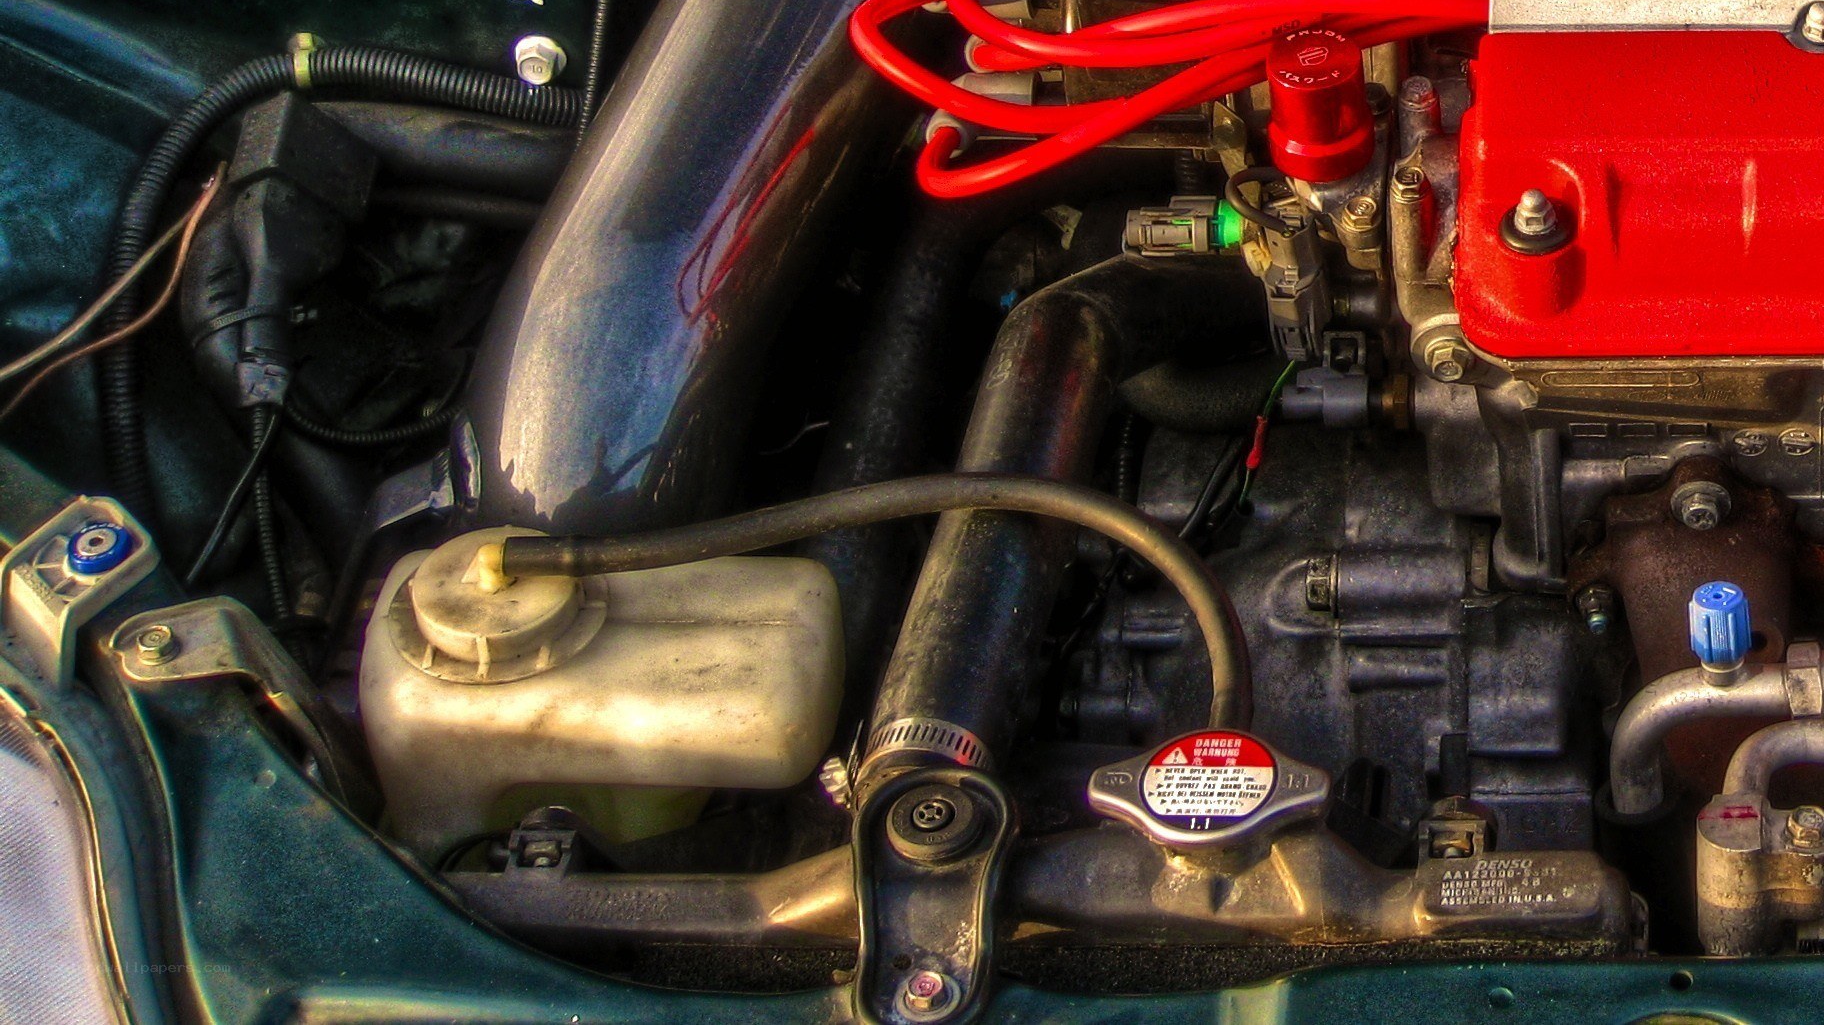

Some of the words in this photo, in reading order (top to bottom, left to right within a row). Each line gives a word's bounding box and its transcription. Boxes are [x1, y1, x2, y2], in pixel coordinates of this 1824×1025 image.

[1195, 739, 1242, 747] DANGER
[1193, 748, 1240, 757] WARNUNG
[1190, 818, 1210, 829] 1.1
[1475, 859, 1534, 870] DENSO
